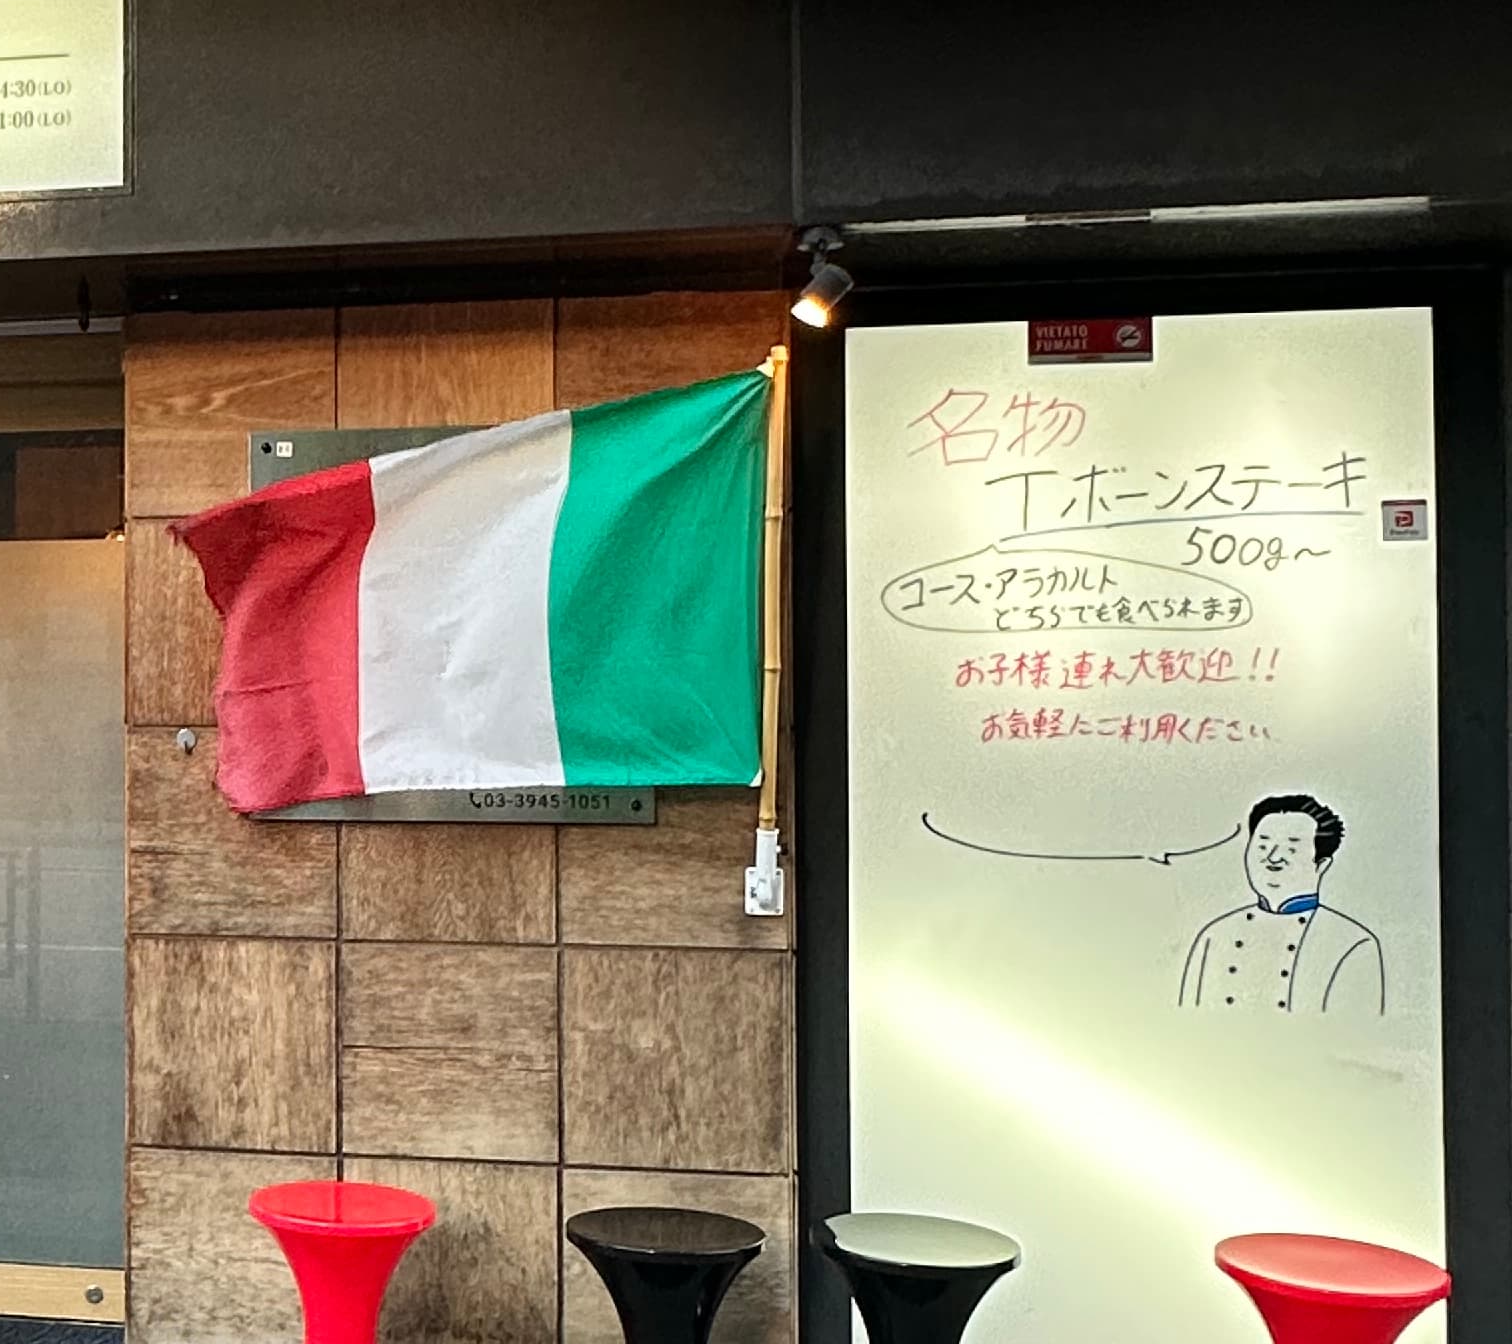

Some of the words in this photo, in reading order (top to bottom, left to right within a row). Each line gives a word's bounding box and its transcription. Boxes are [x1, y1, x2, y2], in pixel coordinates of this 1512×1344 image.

[1035, 324, 1089, 338] VIETATO
[906, 387, 1087, 467] 名物
[994, 594, 1245, 632] どちらでも食べられます
[980, 706, 1273, 744] お気軽にご利用ください
[484, 792, 611, 810] 03-3945-1051
